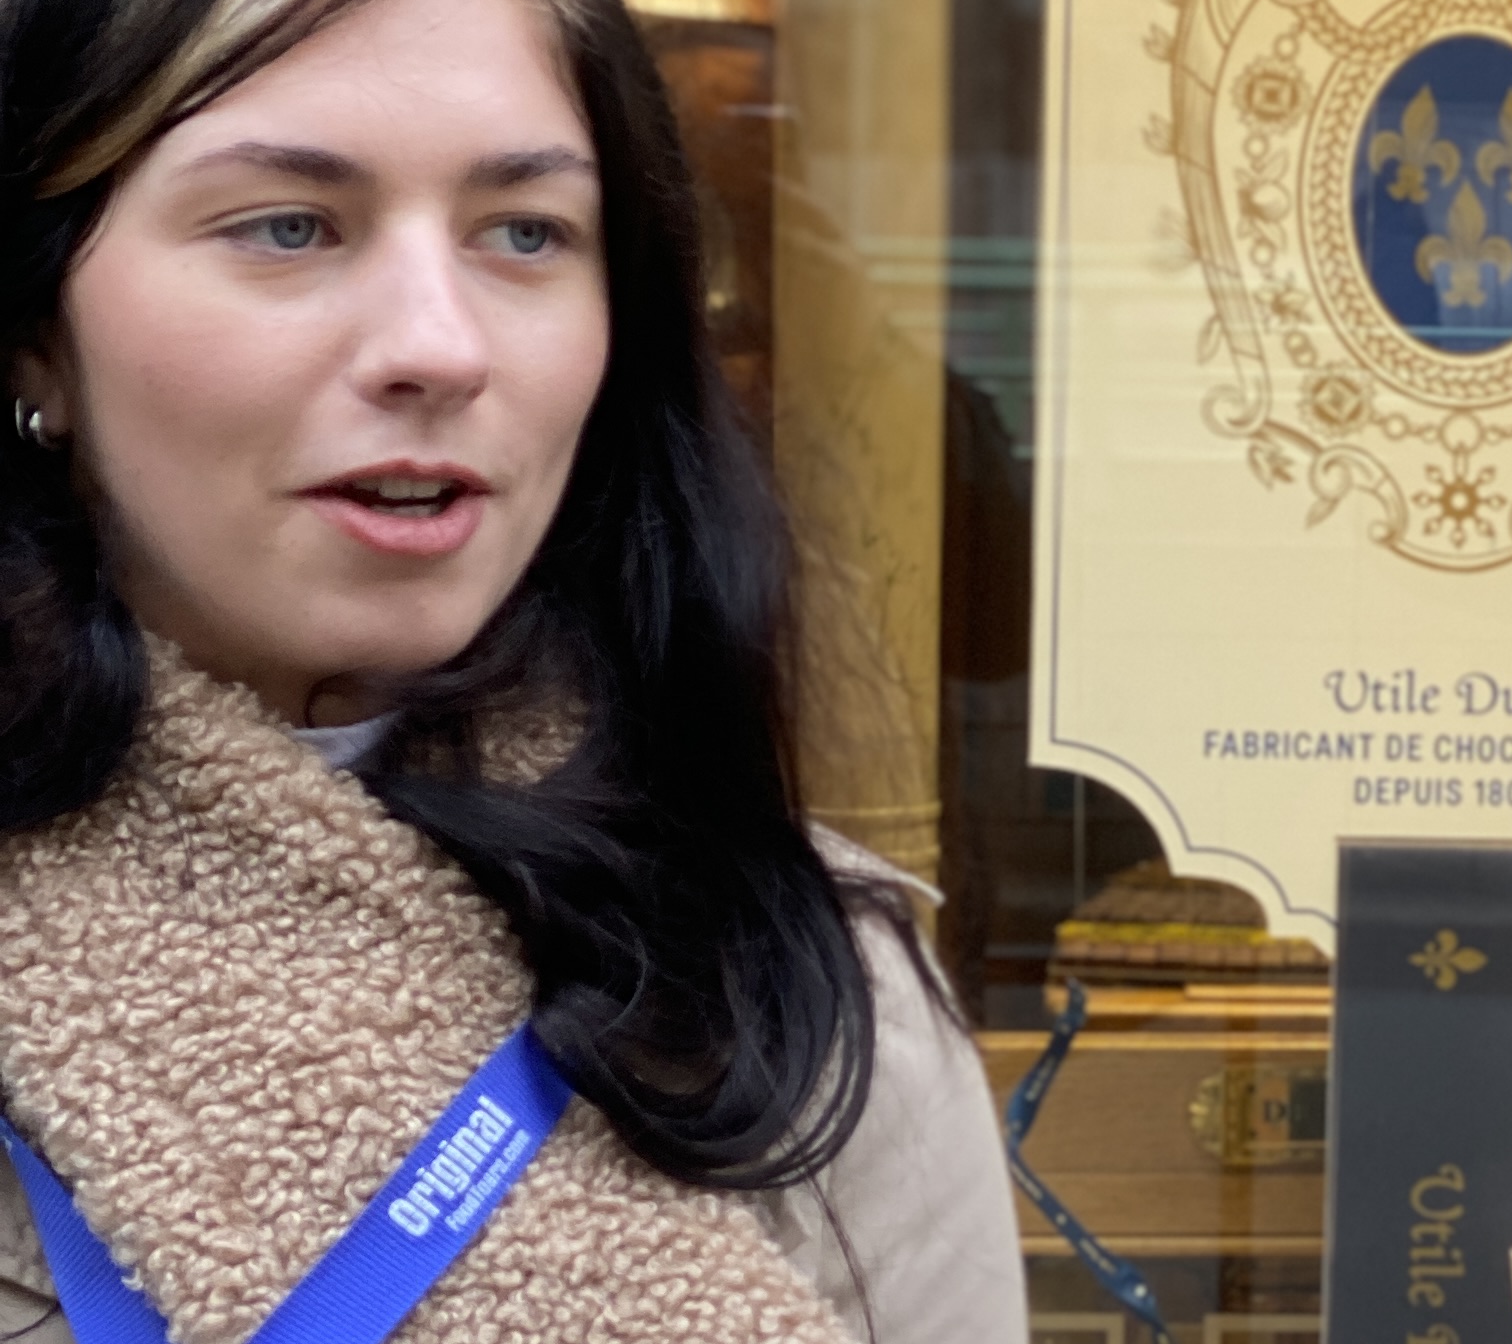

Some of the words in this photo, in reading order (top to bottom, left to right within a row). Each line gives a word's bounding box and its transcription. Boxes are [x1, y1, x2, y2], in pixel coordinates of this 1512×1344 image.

[1203, 730, 1375, 760] FABRICANT
[1384, 733, 1423, 762] DE
[1353, 777, 1463, 806] DEPUIS
[388, 1094, 514, 1237] Original
